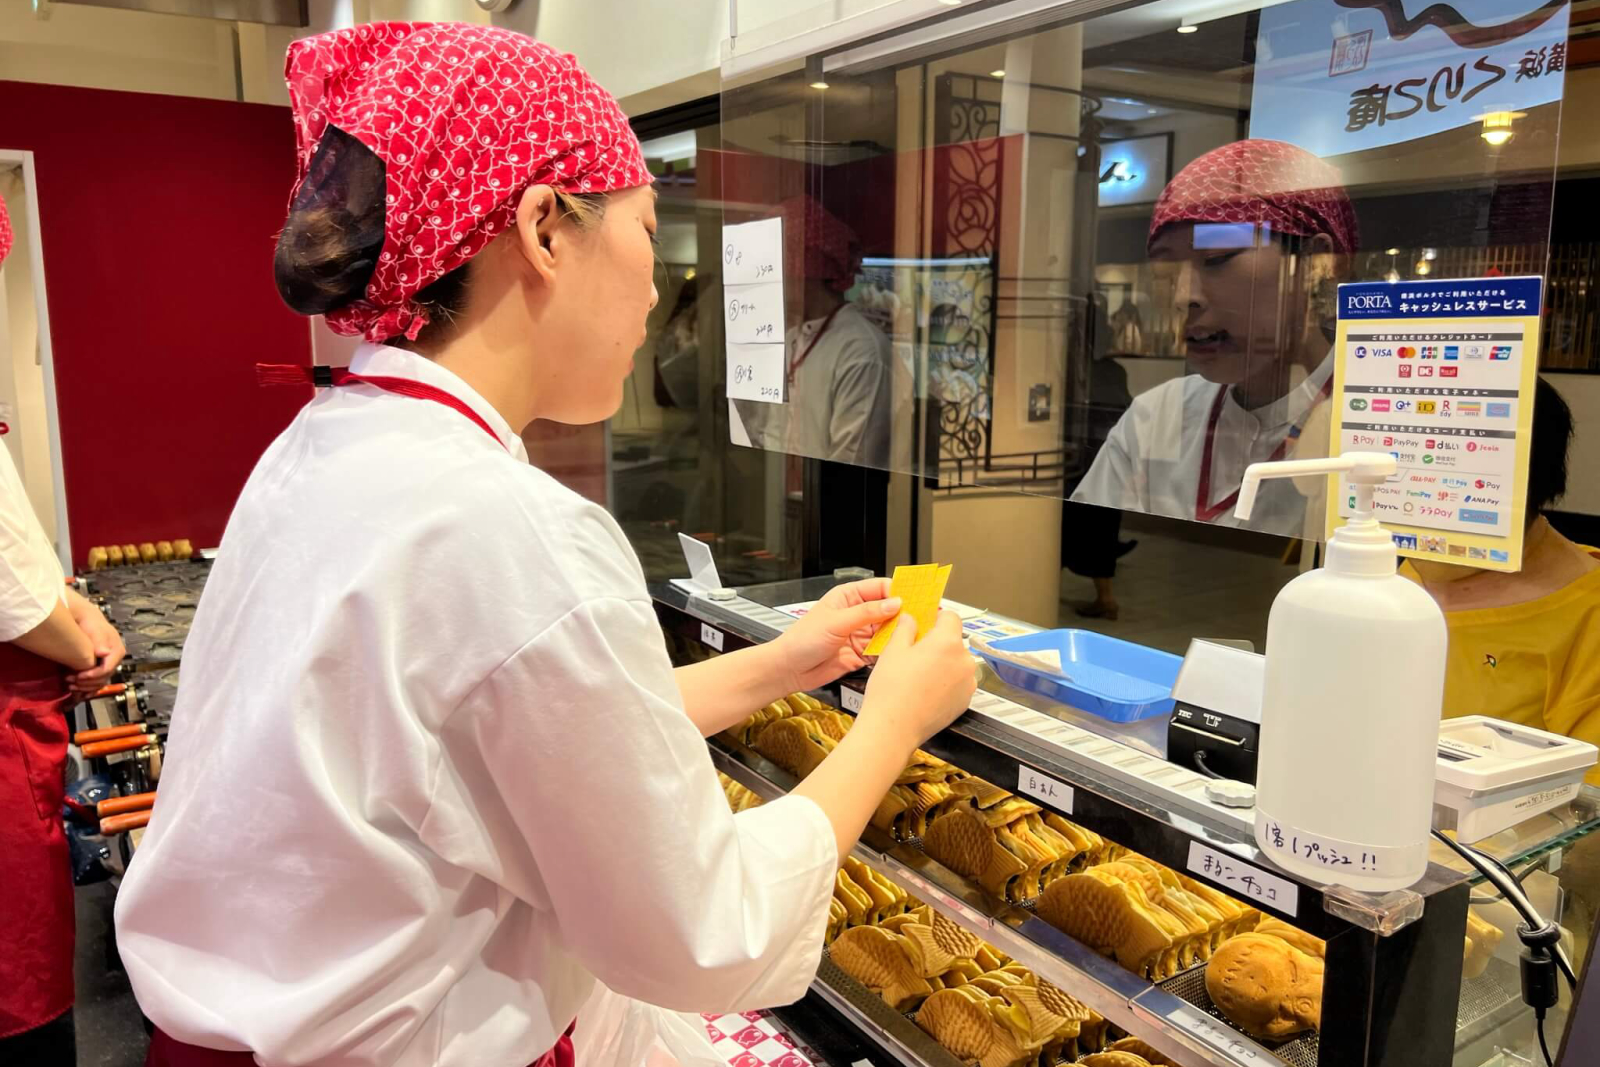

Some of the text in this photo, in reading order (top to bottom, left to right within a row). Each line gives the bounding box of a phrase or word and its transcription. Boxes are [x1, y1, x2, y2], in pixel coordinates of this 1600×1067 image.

[1347, 295, 1392, 309] PORTA
[1399, 299, 1527, 312] キャッシュレスサービス
[1372, 348, 1392, 357] VISA
[1368, 387, 1489, 396] ご利用いただける電子マネー
[1366, 424, 1486, 436] ご利用いただけるコード支払い
[1360, 435, 1375, 446] Pay
[1393, 438, 1419, 448] PayPay
[1486, 481, 1500, 490] Pay
[1471, 496, 1499, 506] ANA Pay
[1029, 776, 1058, 798] 白あん
